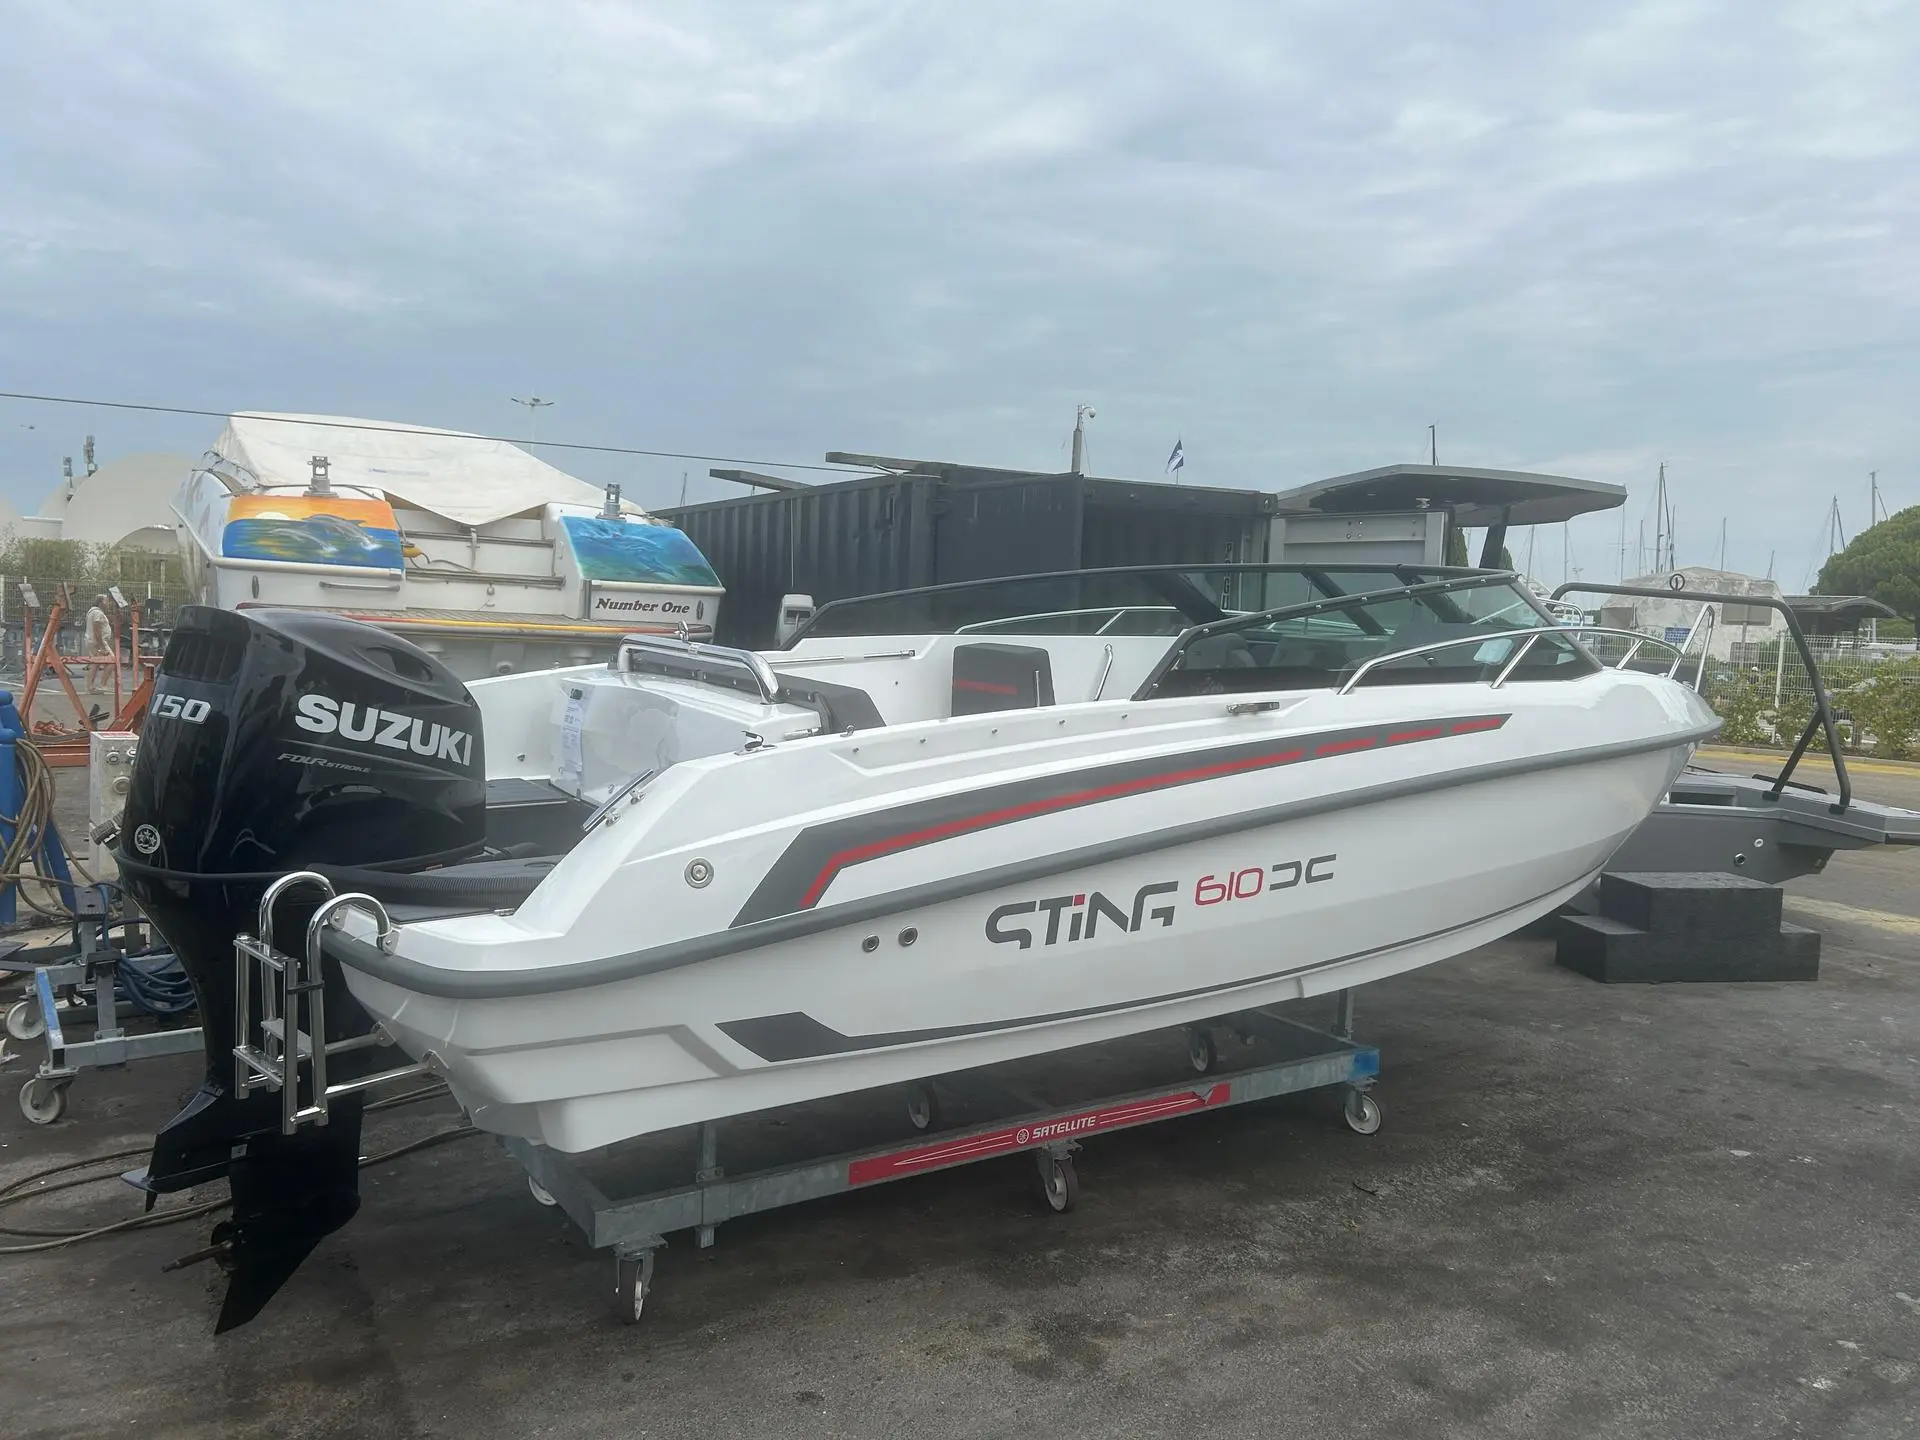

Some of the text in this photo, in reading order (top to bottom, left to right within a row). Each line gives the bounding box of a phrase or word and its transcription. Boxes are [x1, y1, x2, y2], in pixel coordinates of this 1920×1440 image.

[595, 598, 691, 614] Number One
[151, 693, 212, 725] 150
[295, 694, 473, 766] SUZUKI
[1194, 867, 1264, 906] 610
[1032, 1116, 1097, 1139] SATELLITE
